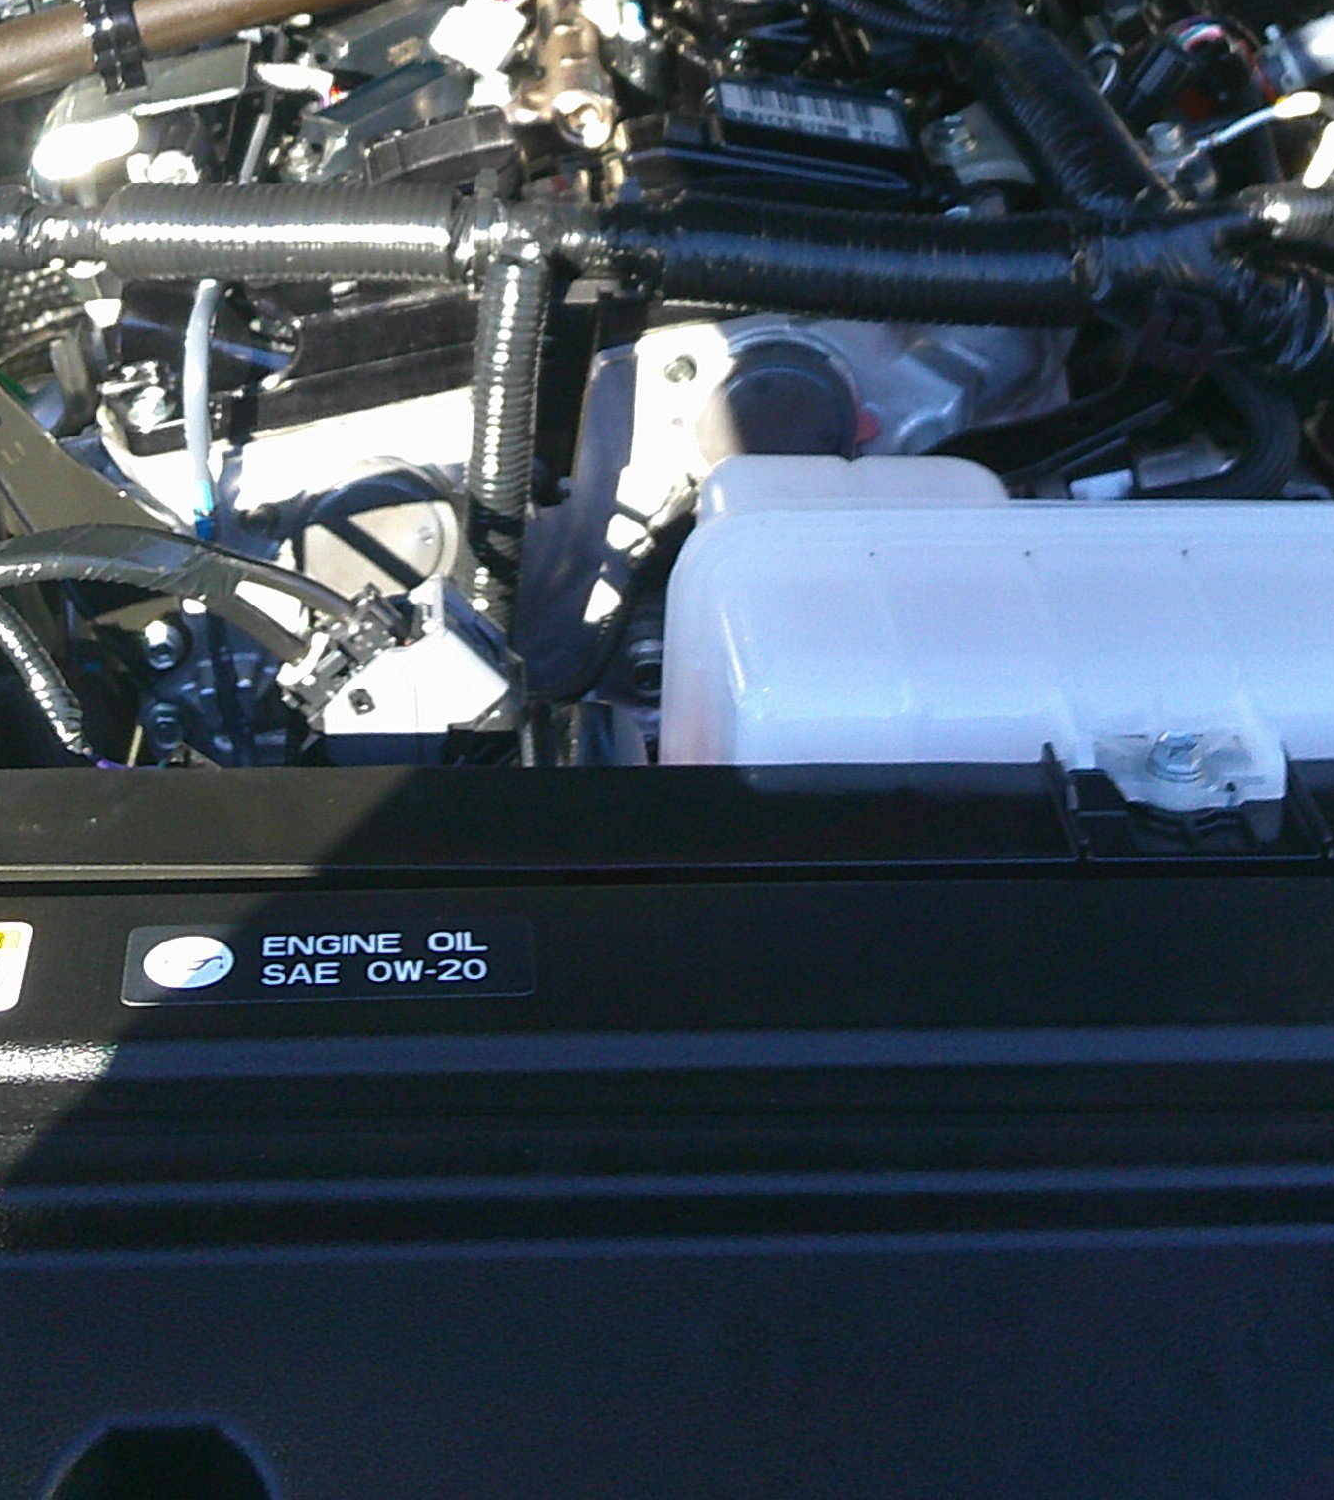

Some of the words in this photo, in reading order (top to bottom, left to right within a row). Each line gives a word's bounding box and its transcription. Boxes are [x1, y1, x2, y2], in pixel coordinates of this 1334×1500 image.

[261, 932, 402, 955] ENGINE
[427, 931, 488, 953] OIL
[260, 961, 341, 986] SAE
[366, 958, 488, 982] 0W-20
